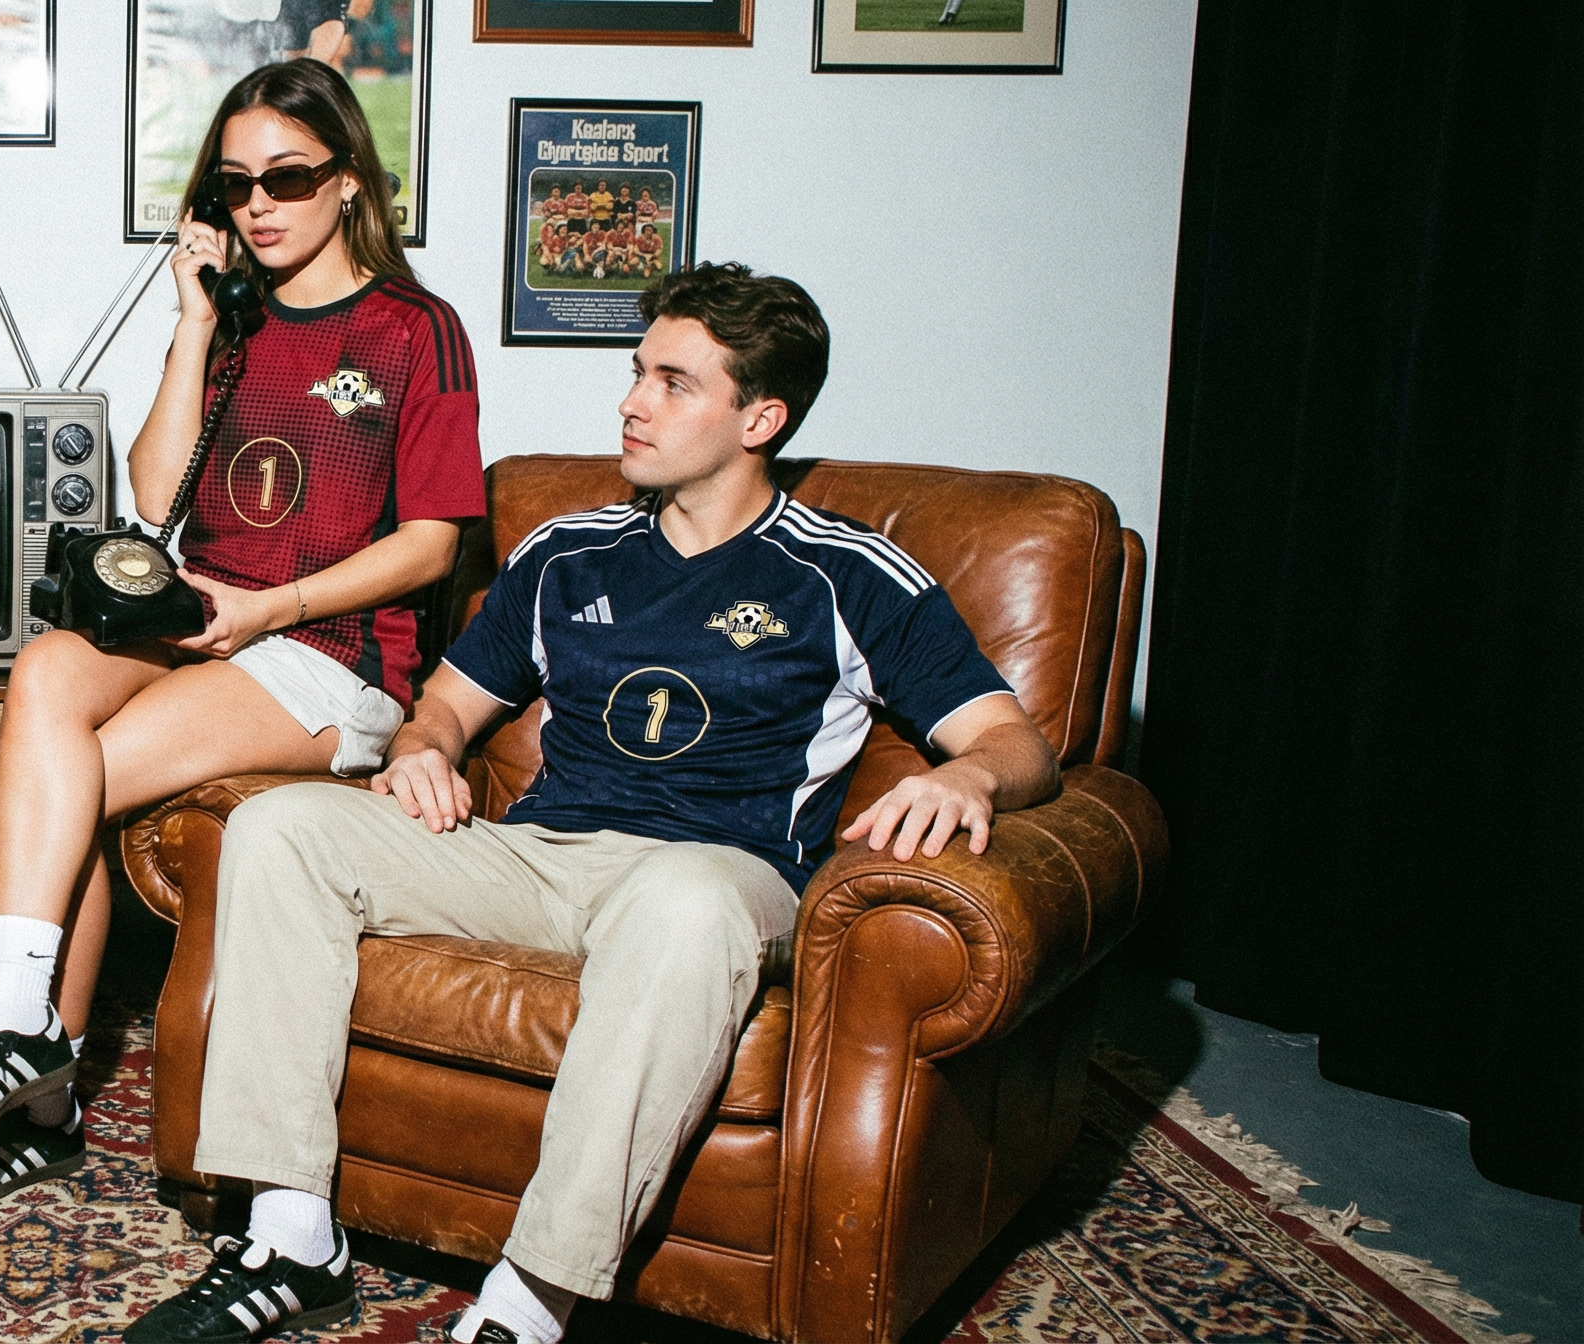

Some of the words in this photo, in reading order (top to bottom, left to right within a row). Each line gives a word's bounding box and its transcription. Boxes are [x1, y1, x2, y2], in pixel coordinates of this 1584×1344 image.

[623, 142, 669, 166] Sport
[258, 456, 277, 511] 1
[644, 688, 669, 744] 1
